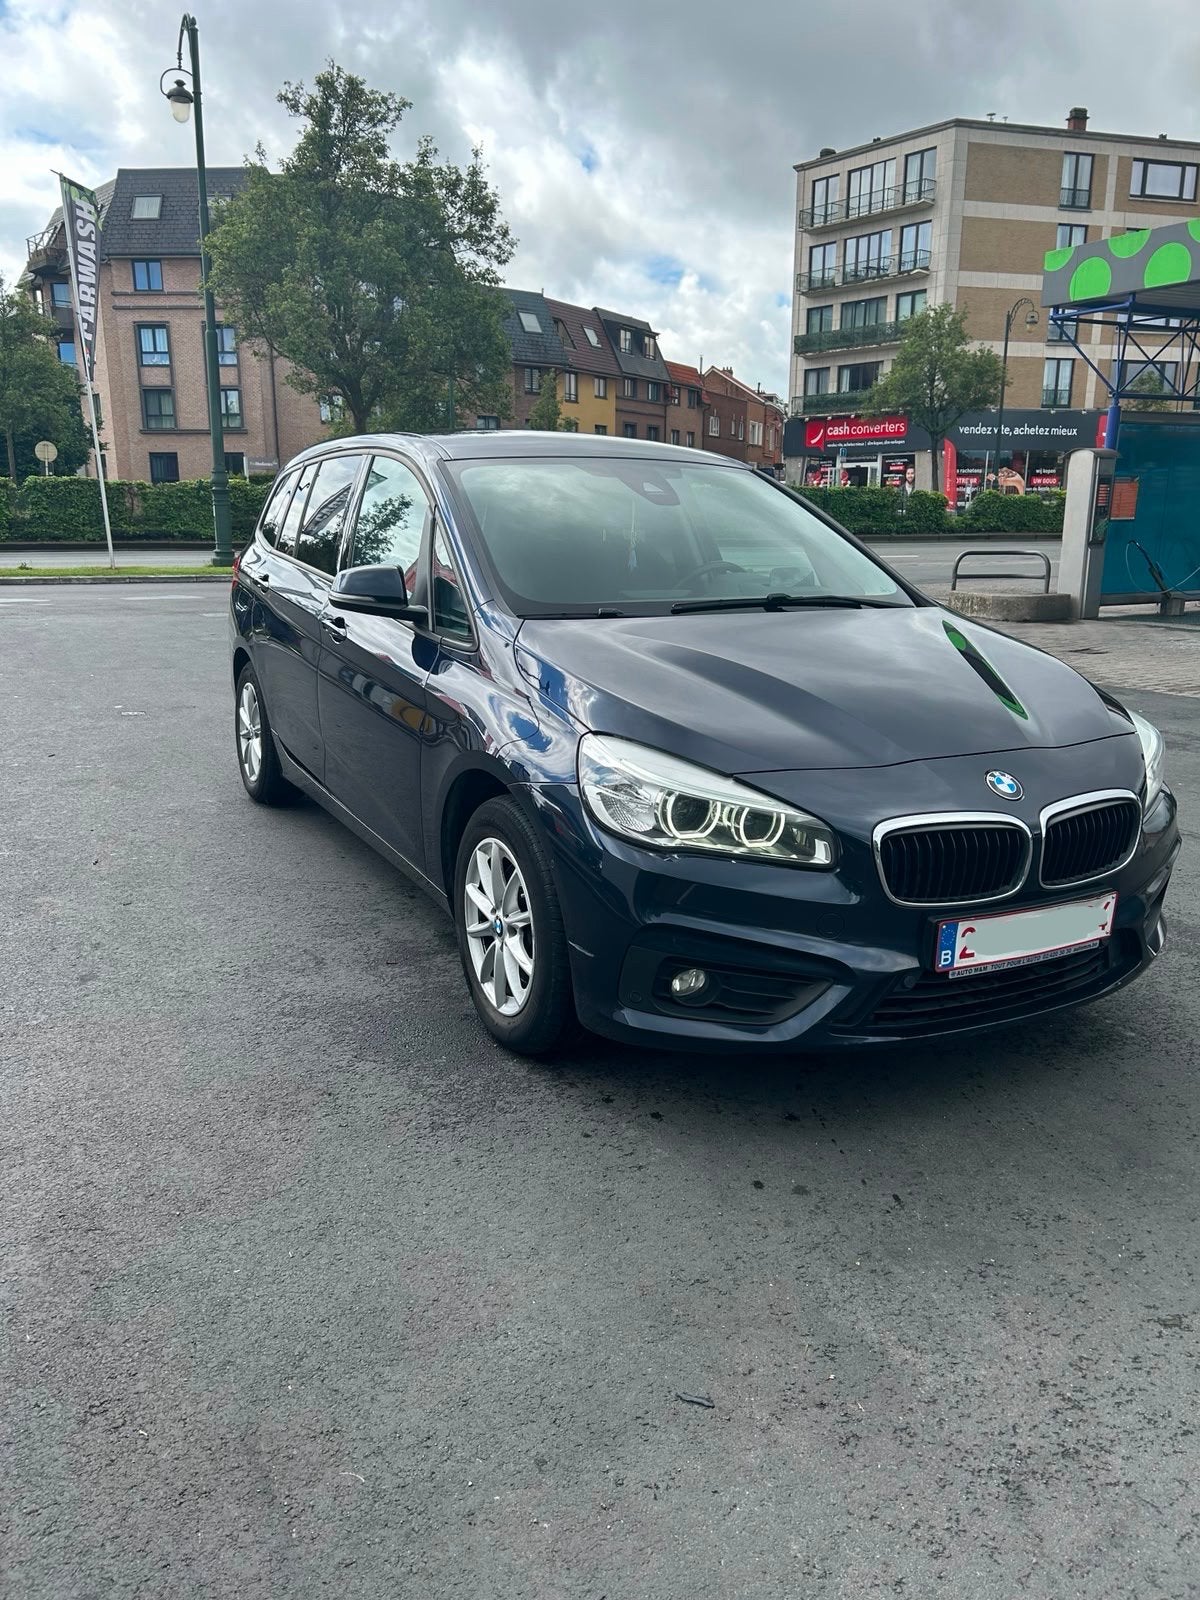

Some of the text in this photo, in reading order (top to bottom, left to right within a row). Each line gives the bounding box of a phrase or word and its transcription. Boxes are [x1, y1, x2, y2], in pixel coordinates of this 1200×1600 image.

[827, 421, 905, 436] cash converters
[958, 422, 1078, 436] vendez vte, achetez mieux
[941, 950, 952, 965] B
[957, 968, 973, 977] AUTO
[991, 962, 1006, 970] TOUT
[1007, 959, 1020, 967] POUR
